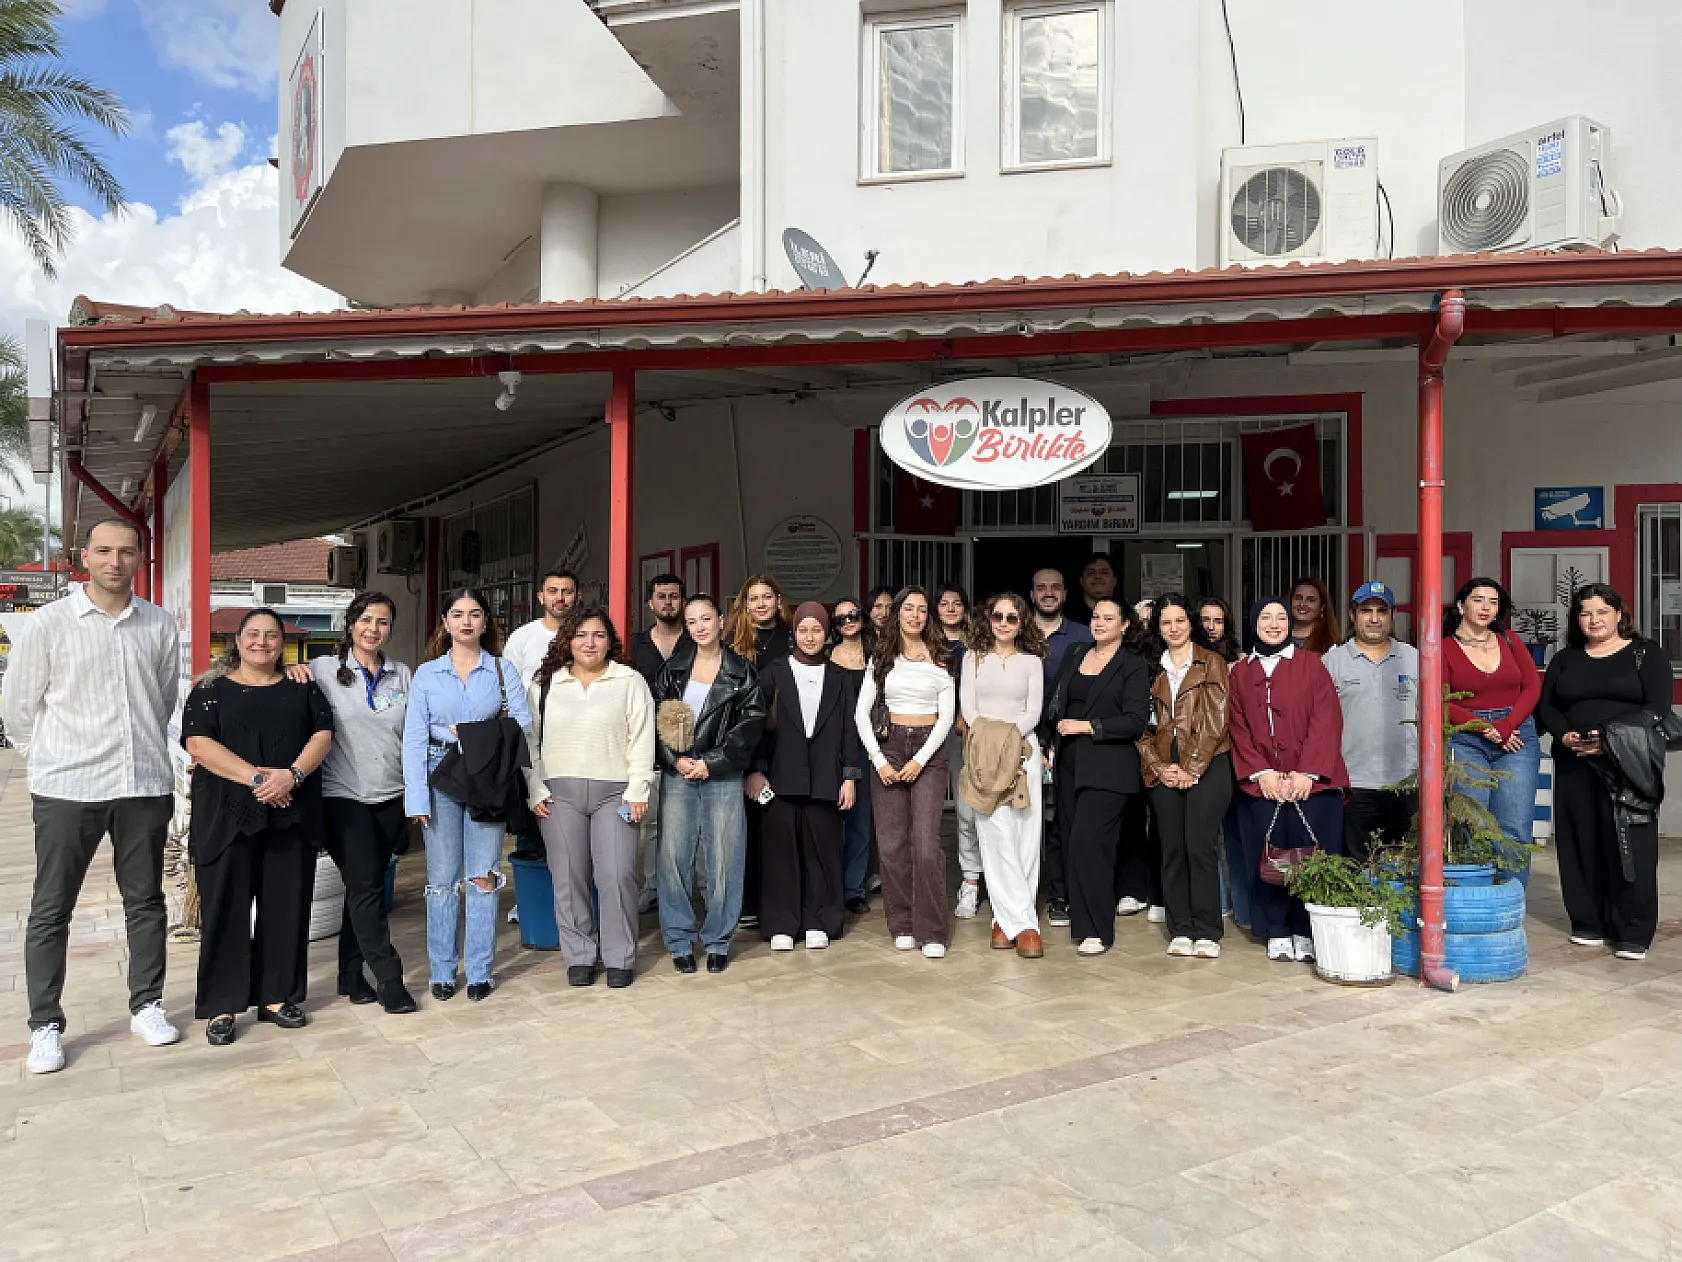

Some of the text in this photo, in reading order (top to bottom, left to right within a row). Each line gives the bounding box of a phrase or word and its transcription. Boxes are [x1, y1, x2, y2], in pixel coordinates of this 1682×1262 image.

[1538, 129, 1565, 145] airtel
[982, 397, 1086, 433] Kalpler
[972, 429, 1087, 464] Birlikte
[1062, 519, 1099, 530] YARDIM
